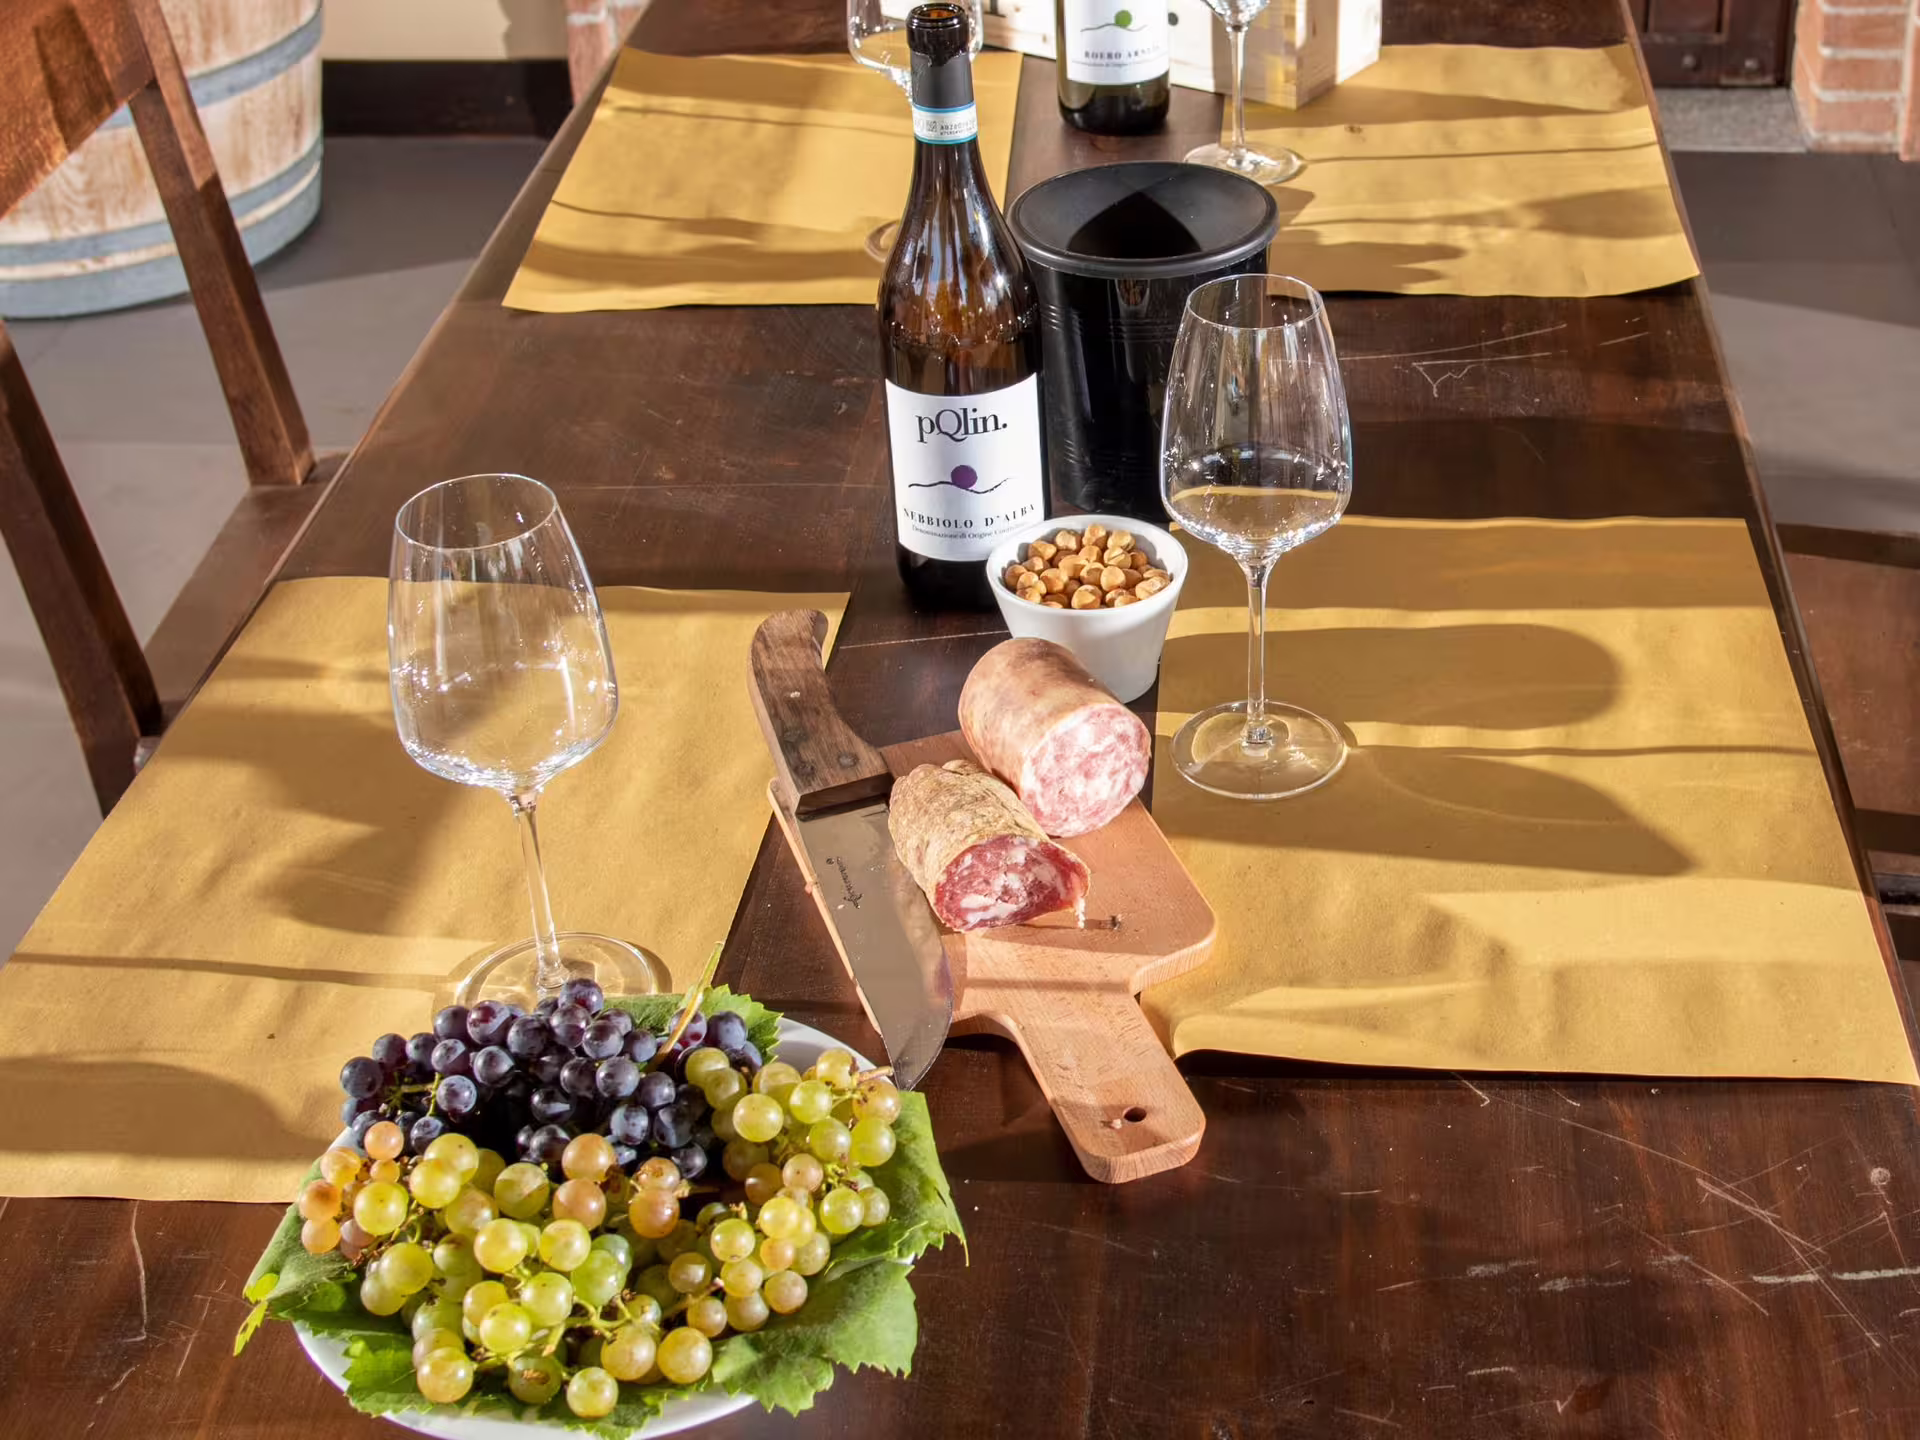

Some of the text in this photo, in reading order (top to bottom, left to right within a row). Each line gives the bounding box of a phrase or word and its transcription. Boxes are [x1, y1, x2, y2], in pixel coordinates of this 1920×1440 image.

[1084, 41, 1160, 60] ROERO ARNE
[915, 407, 1008, 444] pQlin.
[903, 504, 1035, 529] NEBBIOLO D'ALBA
